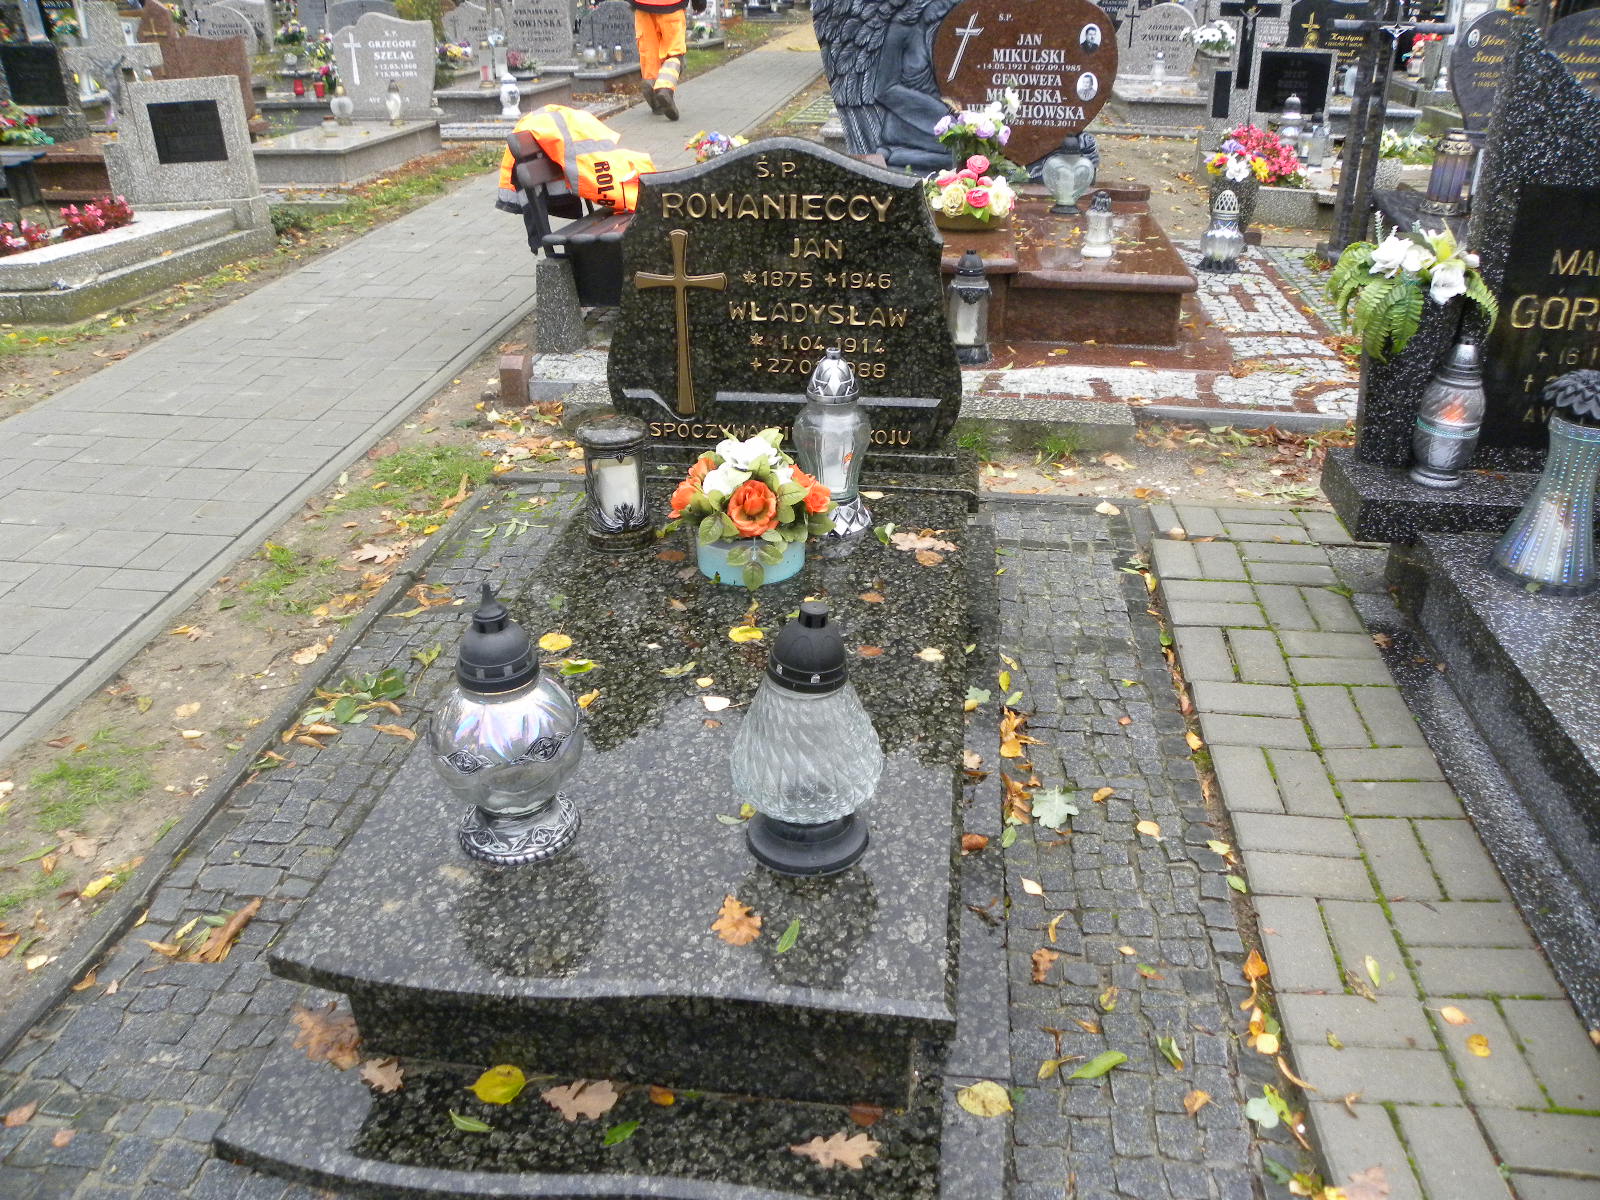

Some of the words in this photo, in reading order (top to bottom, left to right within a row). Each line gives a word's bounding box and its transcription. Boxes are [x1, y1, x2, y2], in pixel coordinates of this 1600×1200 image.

[368, 40, 417, 48] GRZEGORZ
[1017, 33, 1043, 46] JAN
[992, 49, 1066, 64] MIKULSKI
[992, 73, 1063, 87] GENOWEFA
[986, 88, 1068, 103] MIULSKA-
[661, 193, 894, 223] ROMANIECCY
[789, 237, 844, 260] JAN
[728, 301, 908, 329] WŁADYSŁAW
